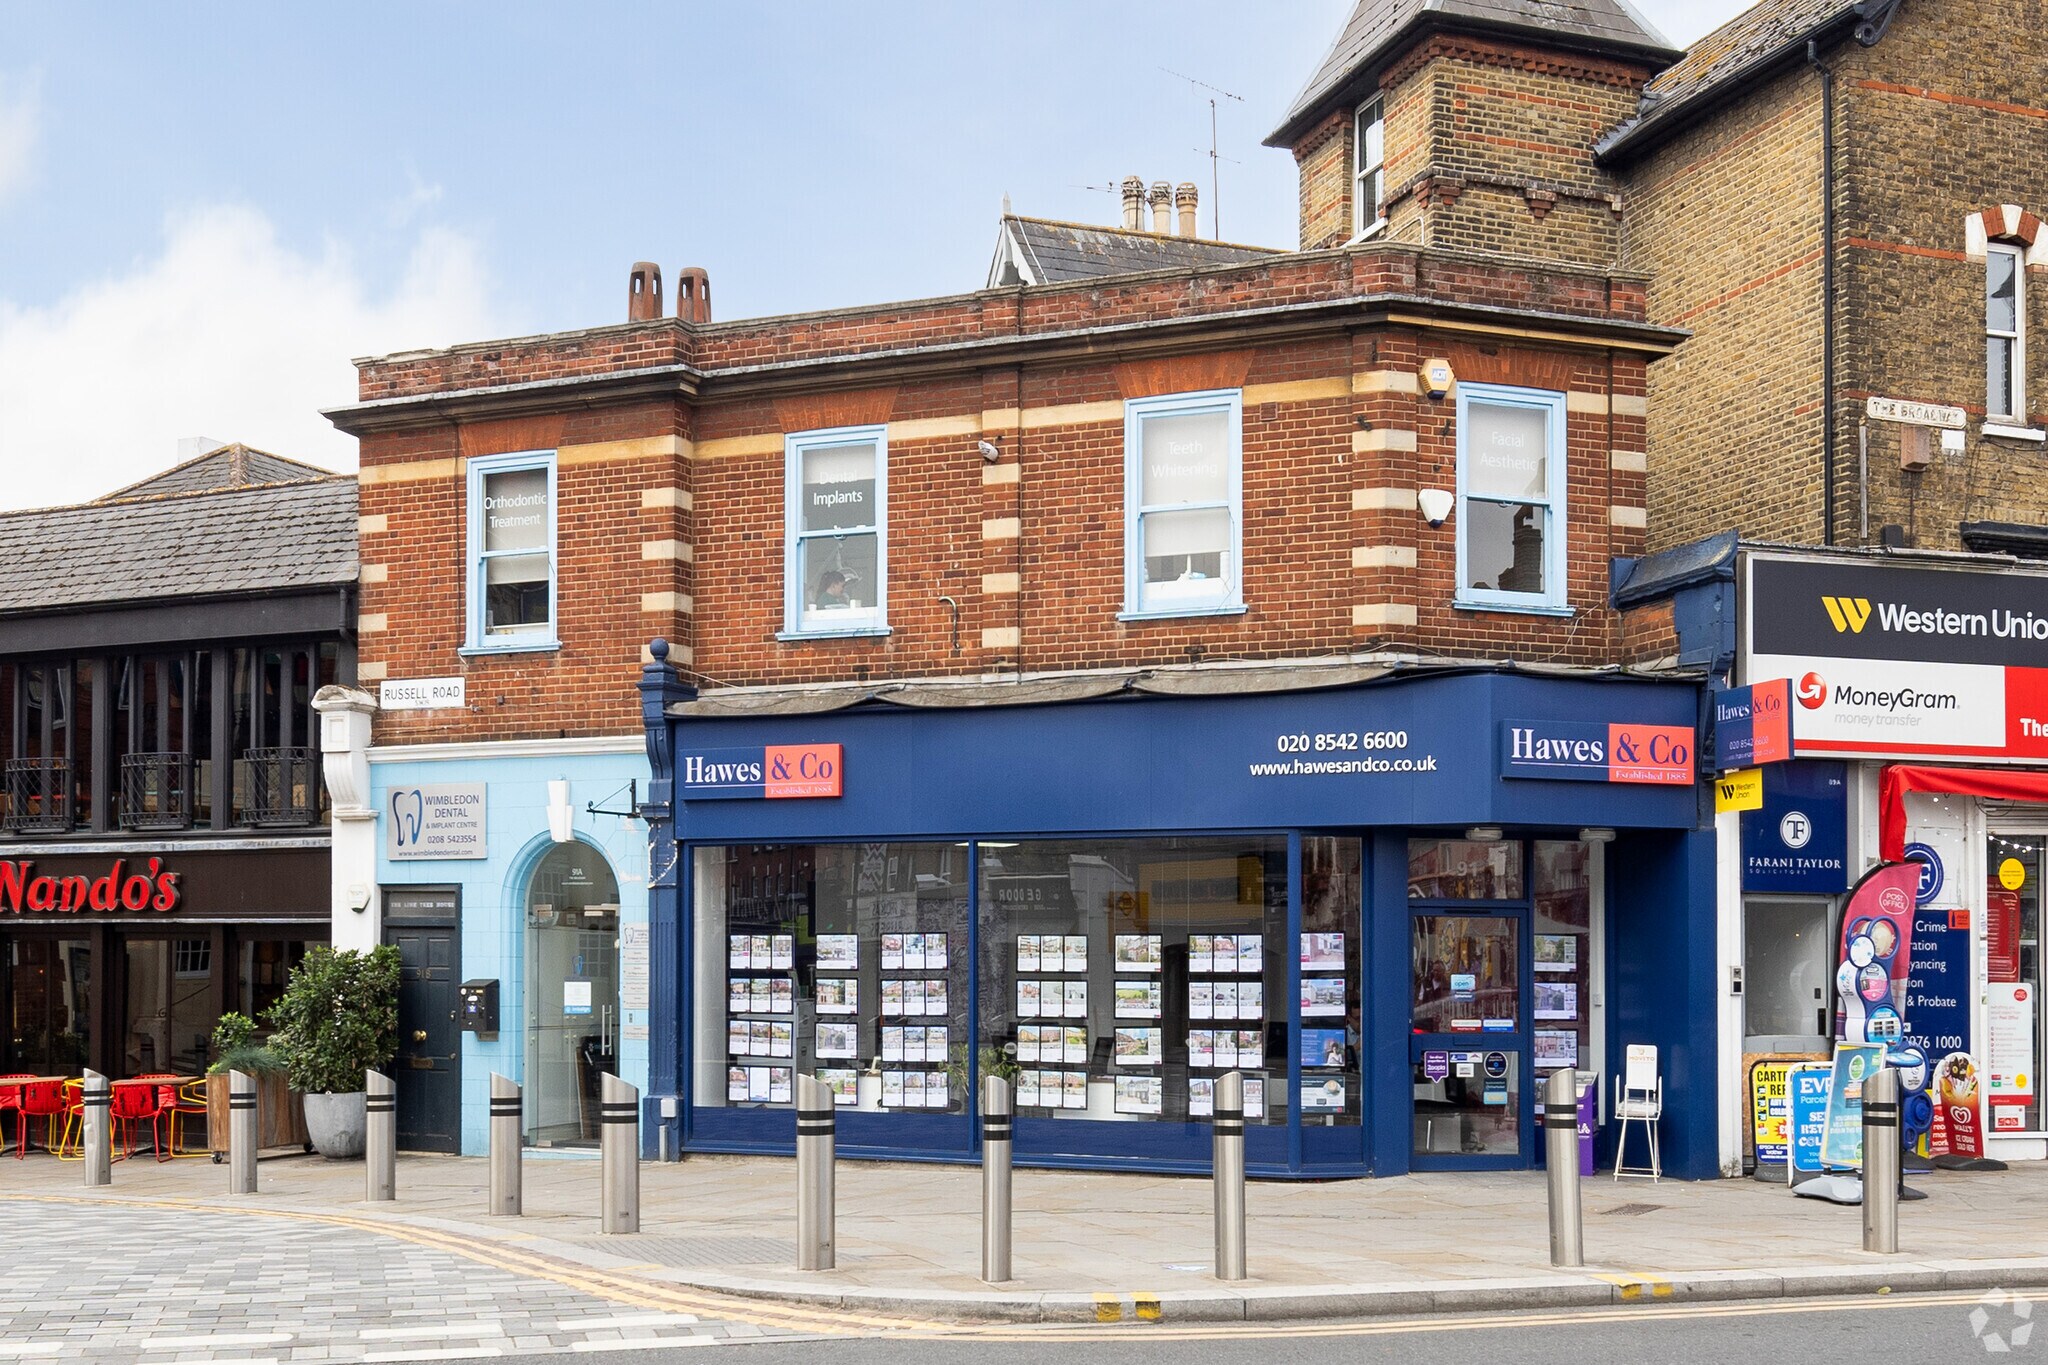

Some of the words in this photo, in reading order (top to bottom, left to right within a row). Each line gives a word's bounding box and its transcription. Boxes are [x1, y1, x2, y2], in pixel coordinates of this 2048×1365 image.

[1873, 401, 1896, 416] THE
[1492, 431, 1524, 448] Facial
[1168, 441, 1203, 455] Teeth
[820, 470, 857, 485] Dental
[1152, 463, 1218, 478] Whitening
[484, 492, 547, 510] Orthodontic
[814, 490, 863, 508] Implants
[490, 514, 541, 529] Treatment
[1878, 603, 1987, 636] Western
[1992, 609, 2048, 641] Unio
[385, 688, 427, 700] RUSSELL
[433, 686, 460, 698] ROAD
[1834, 686, 1956, 711] MoneyGram
[1718, 704, 1750, 721] Hawes
[1754, 697, 1762, 713] &
[1766, 694, 1780, 711] Co
[1834, 712, 1874, 728] money
[1876, 713, 1922, 727] transfer
[1277, 735, 1310, 752] 020
[1314, 733, 1358, 751] 8542
[1363, 731, 1408, 750] 6600
[1512, 728, 1603, 762] Hawes
[1616, 733, 1640, 763] &
[1650, 734, 1687, 764] Co
[685, 756, 761, 783] Hawes
[771, 753, 792, 780] &
[800, 752, 833, 779] Co
[1250, 755, 1437, 775] www.hawesandco.co.uk
[425, 795, 479, 805] WIMBLEDON
[435, 808, 468, 818] DENTAL
[427, 836, 445, 844] 0208
[447, 835, 477, 843] 5423554
[1749, 857, 1793, 868] FARANI
[1796, 859, 1841, 869] TAYLOR
[0, 856, 180, 913] Nando's
[1883, 899, 1904, 909] OFFICE
[1886, 893, 1903, 901] POST
[1916, 920, 1947, 932] Crime
[1908, 960, 1947, 973] yancing
[1907, 996, 1914, 1007] &
[1918, 995, 1957, 1007] Probate
[1936, 1036, 1962, 1049] 1000
[1757, 1071, 1787, 1082] CART
[1770, 1084, 1786, 1095] RE
[1800, 1078, 1831, 1094] EV
[1801, 1096, 1828, 1104] Parcel
[1809, 1112, 1826, 1122] SE
[1801, 1124, 1824, 1134] RET
[1799, 1137, 1822, 1147] COL
